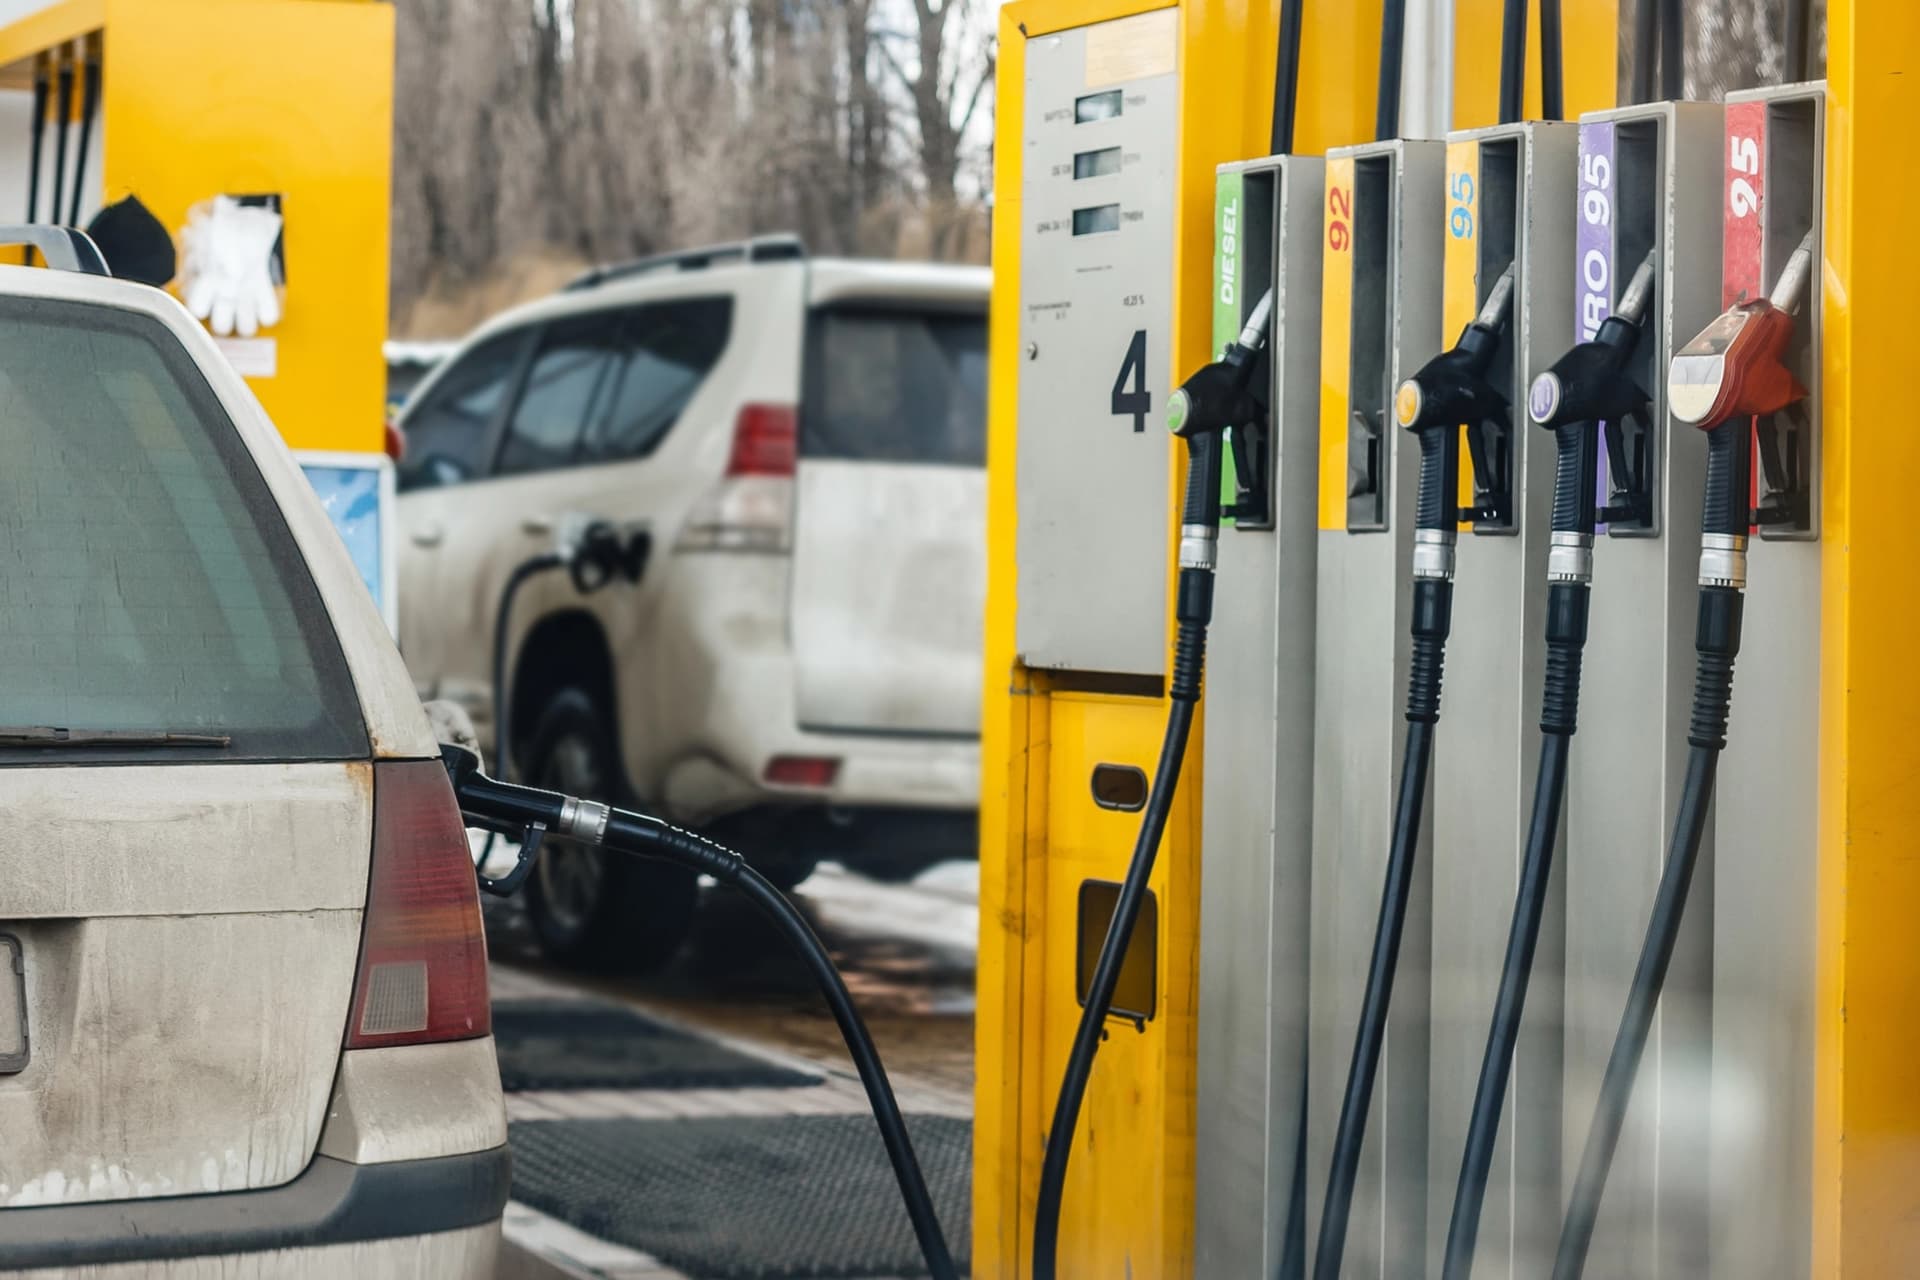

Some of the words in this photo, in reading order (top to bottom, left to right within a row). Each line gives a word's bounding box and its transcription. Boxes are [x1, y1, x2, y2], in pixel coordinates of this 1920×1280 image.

[1450, 172, 1475, 240] 95
[1583, 153, 1611, 227] 95
[1730, 135, 1759, 218] 95
[1220, 197, 1238, 306] DIESEL
[1328, 186, 1350, 252] 92
[1583, 249, 1609, 342] RO
[1111, 328, 1152, 433] 4
